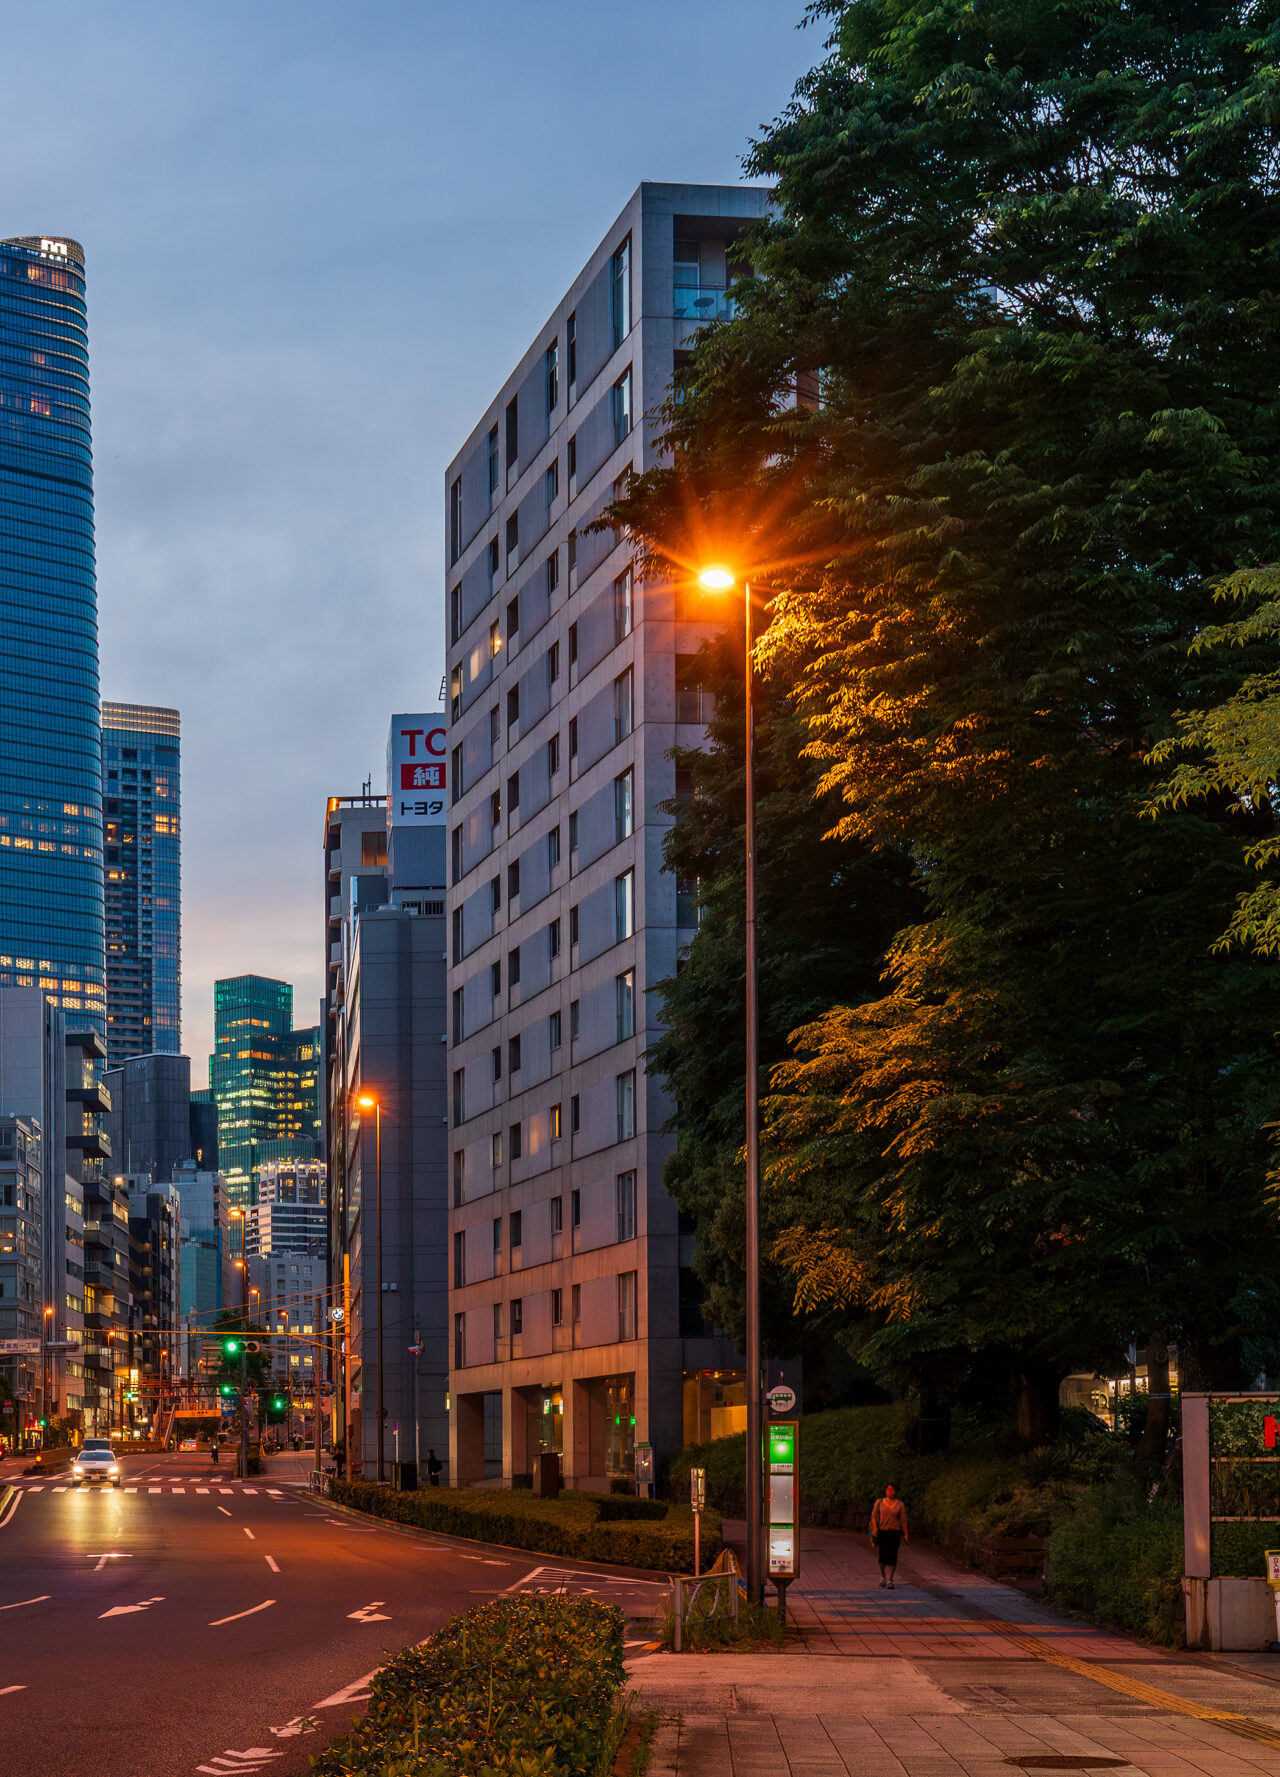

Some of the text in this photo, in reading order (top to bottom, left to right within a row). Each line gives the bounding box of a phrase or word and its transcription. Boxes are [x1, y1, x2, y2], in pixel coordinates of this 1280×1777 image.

[413, 765, 440, 787] 純
[401, 800, 444, 816] トヨタ
